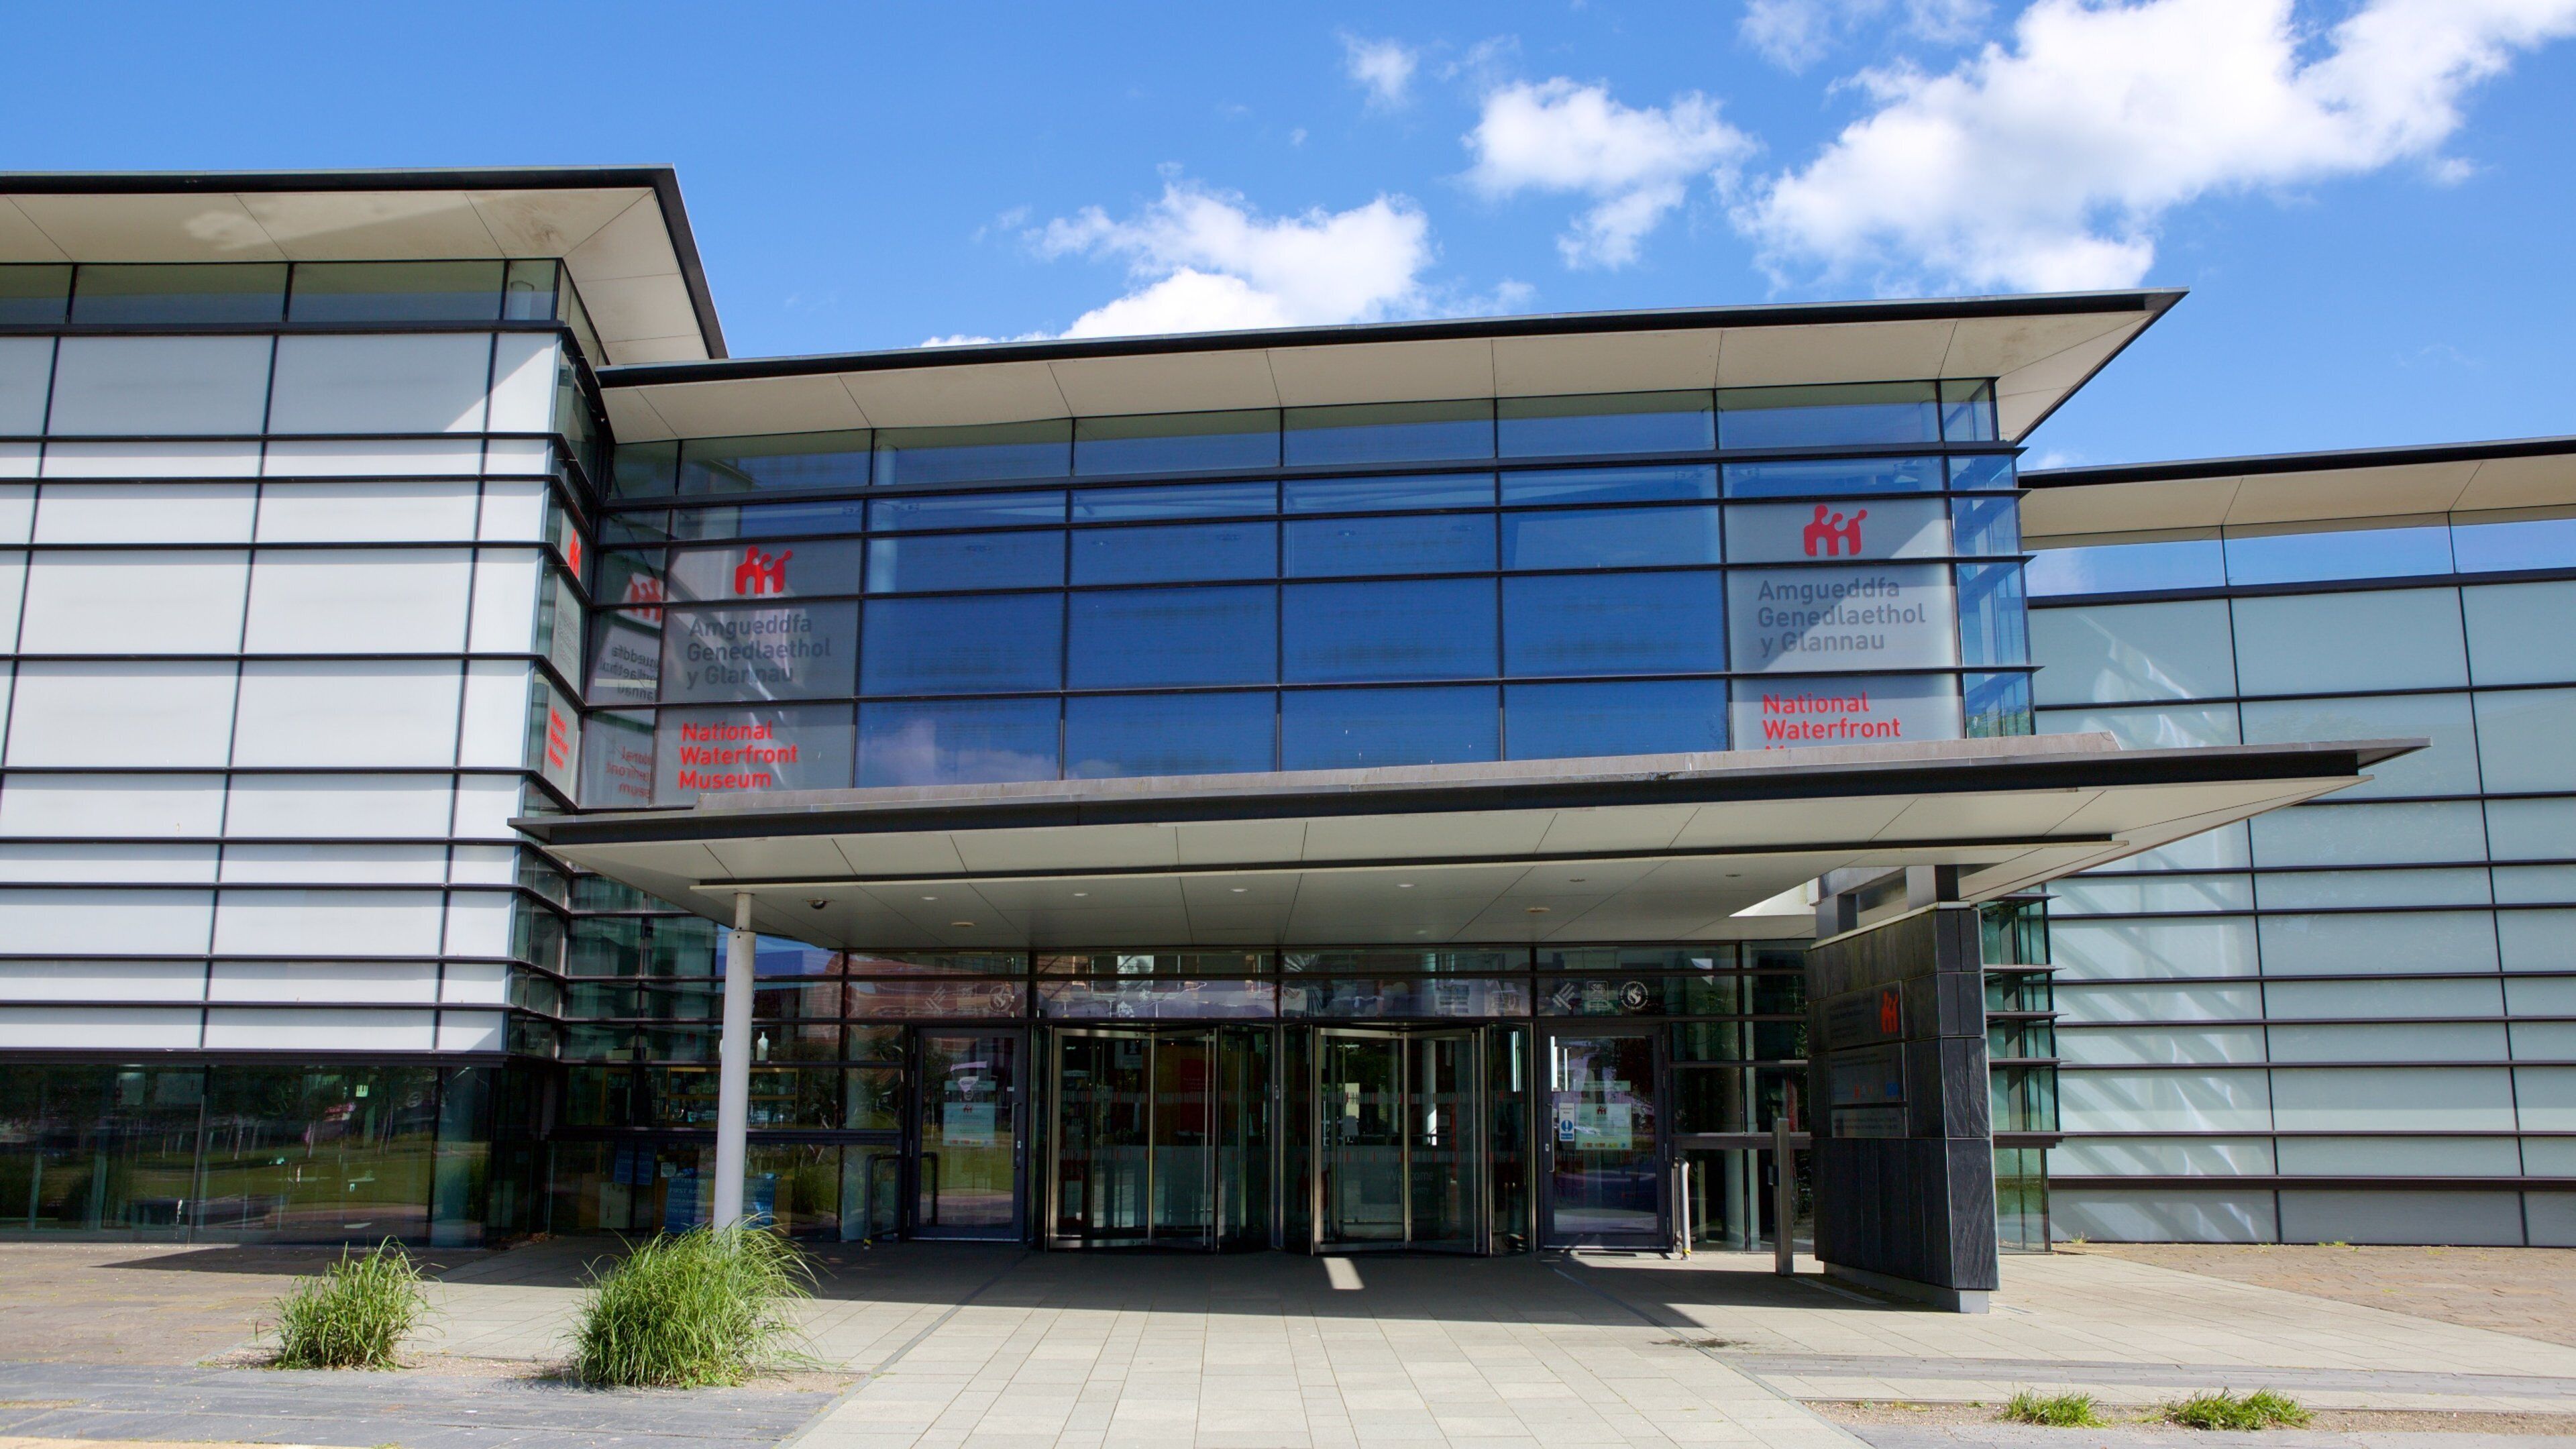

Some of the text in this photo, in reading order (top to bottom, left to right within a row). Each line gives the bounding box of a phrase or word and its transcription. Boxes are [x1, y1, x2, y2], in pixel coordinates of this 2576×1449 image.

[1758, 577, 1900, 604] Amgueddfa
[689, 614, 812, 638] Amgueddfa
[1758, 603, 1925, 627] Genedlaethol
[687, 638, 830, 662] Genedlaethol
[1760, 631, 1884, 658] y Glannau
[686, 665, 794, 689] y Glannau
[1763, 690, 1870, 714] National
[682, 720, 773, 742] National
[1763, 718, 1900, 740] Waterfront
[680, 745, 798, 765] Waterfront
[679, 770, 771, 790] Museum
[1385, 1169, 1434, 1182] Wecome
